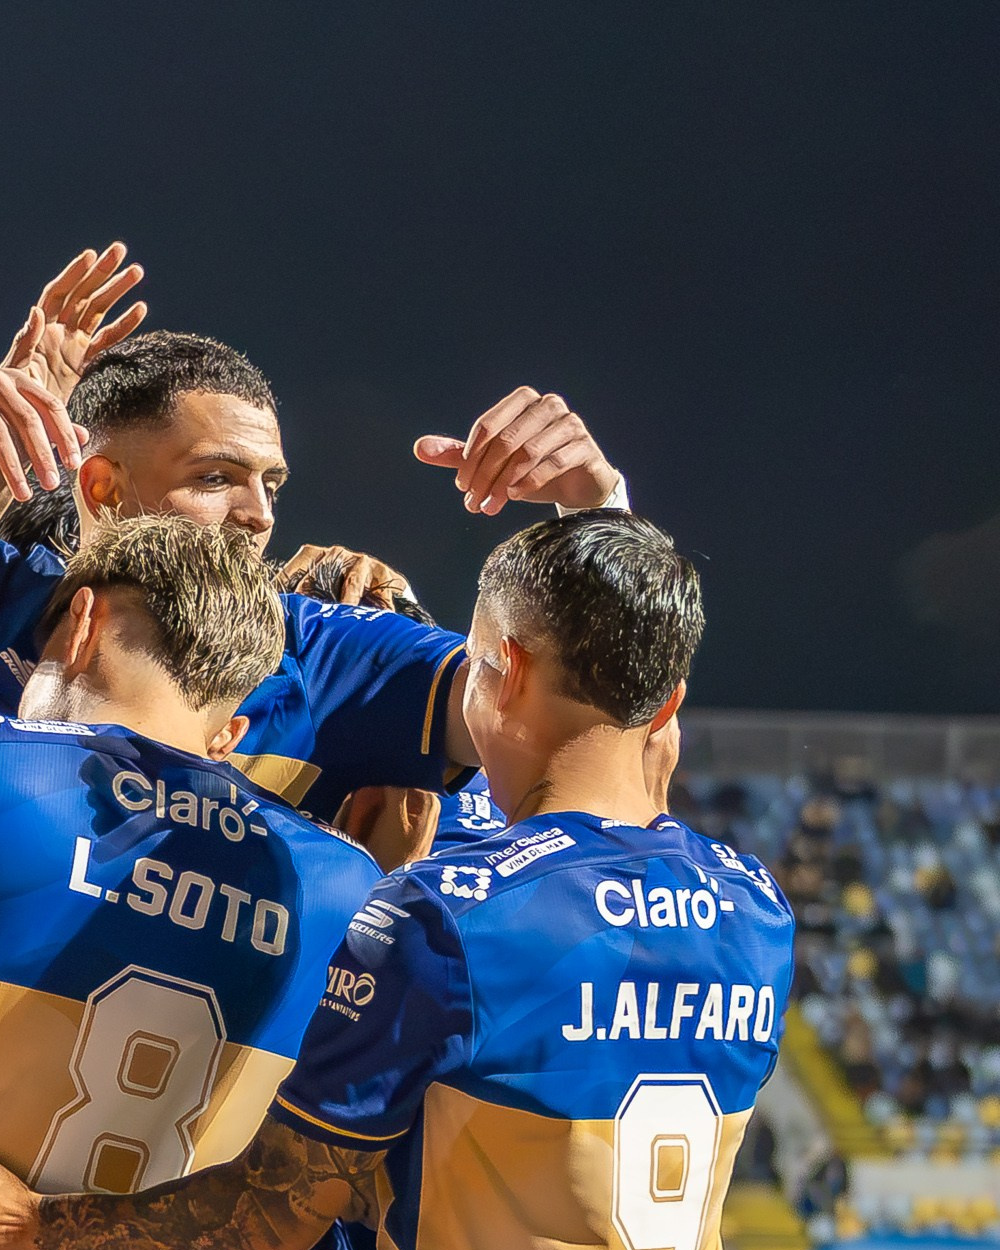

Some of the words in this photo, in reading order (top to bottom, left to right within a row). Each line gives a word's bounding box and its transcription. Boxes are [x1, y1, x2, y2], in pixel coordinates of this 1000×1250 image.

[68, 836, 290, 956] L.SOTO
[561, 981, 776, 1044] J.ALFARO
[29, 964, 227, 1196] 8
